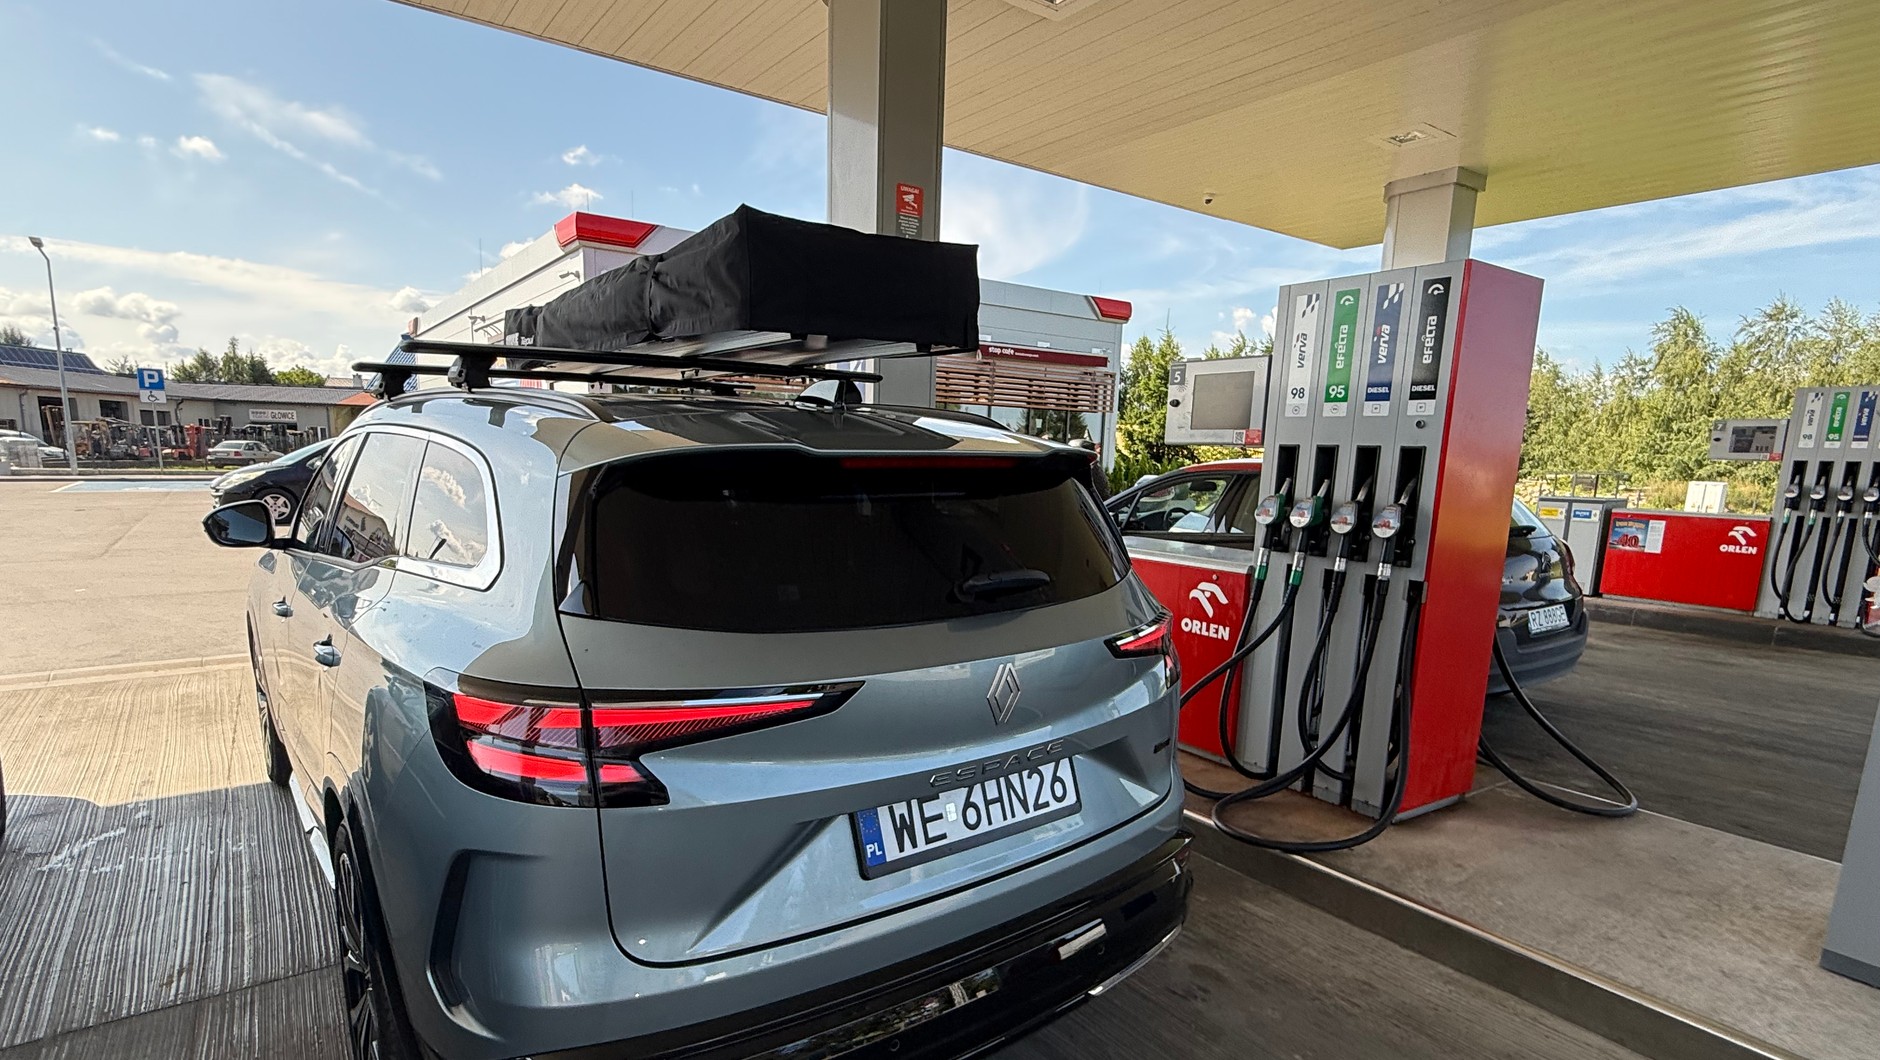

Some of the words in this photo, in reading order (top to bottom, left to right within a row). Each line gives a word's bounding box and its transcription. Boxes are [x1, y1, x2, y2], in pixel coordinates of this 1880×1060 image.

[1335, 324, 1349, 369] efecta
[1376, 324, 1391, 364] verva
[1422, 315, 1438, 364] efecta
[989, 346, 1001, 356] stop
[1002, 347, 1014, 356] cafe
[1296, 332, 1308, 369] verva
[143, 370, 159, 387] P
[1173, 371, 1181, 383] 5
[1290, 387, 1305, 399] 98
[1328, 385, 1345, 398] 95
[1367, 386, 1390, 394] DIESEL
[1411, 384, 1436, 393] DIESEL
[1719, 543, 1758, 555] ORLEN
[1530, 610, 1543, 627] RZ
[1180, 617, 1231, 641] ORLEN
[929, 739, 1064, 788] ESPACE
[888, 791, 948, 854] WE
[961, 757, 1068, 831] 6HN26
[866, 841, 883, 859] PL
